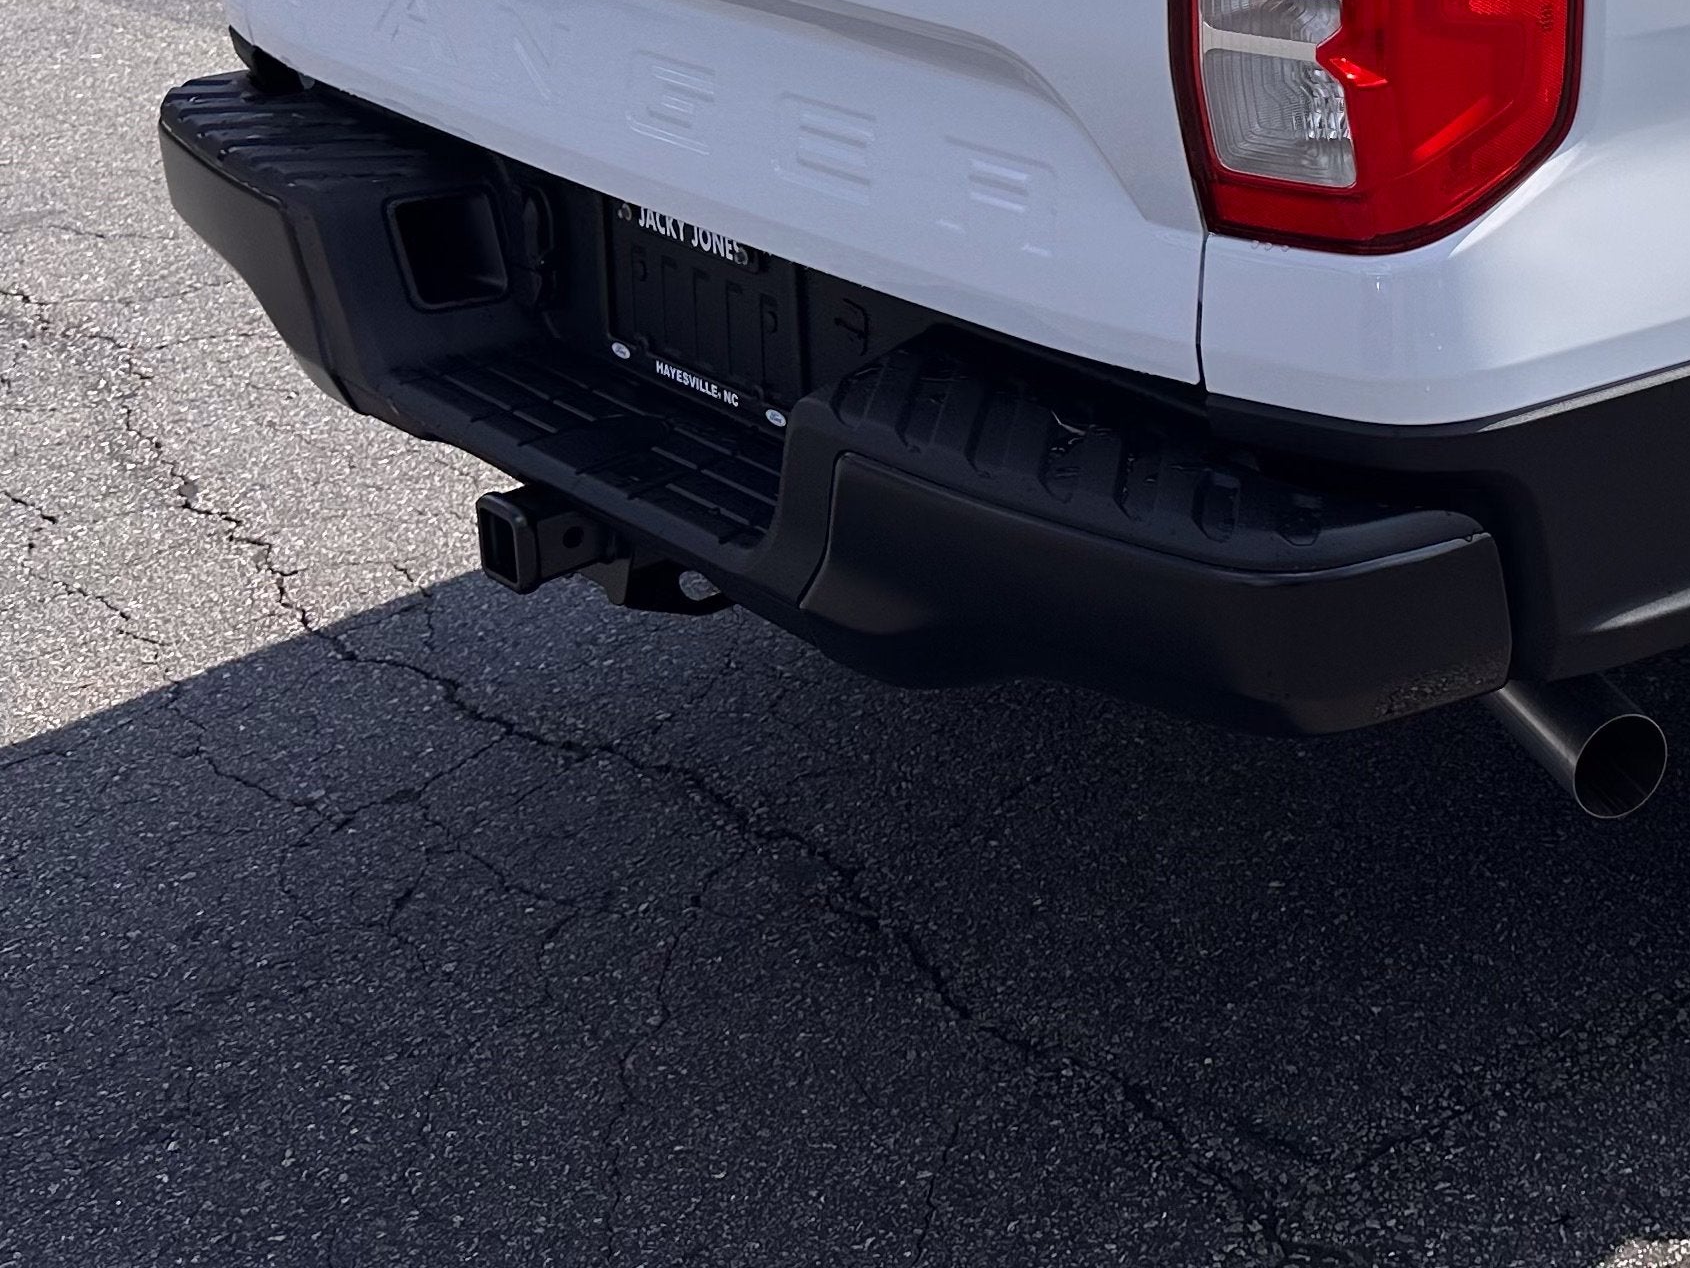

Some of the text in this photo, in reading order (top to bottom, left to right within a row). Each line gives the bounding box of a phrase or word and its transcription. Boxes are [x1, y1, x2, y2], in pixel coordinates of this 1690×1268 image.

[638, 206, 685, 242] JACKY
[655, 359, 739, 408] HAYESVILLE, NC
